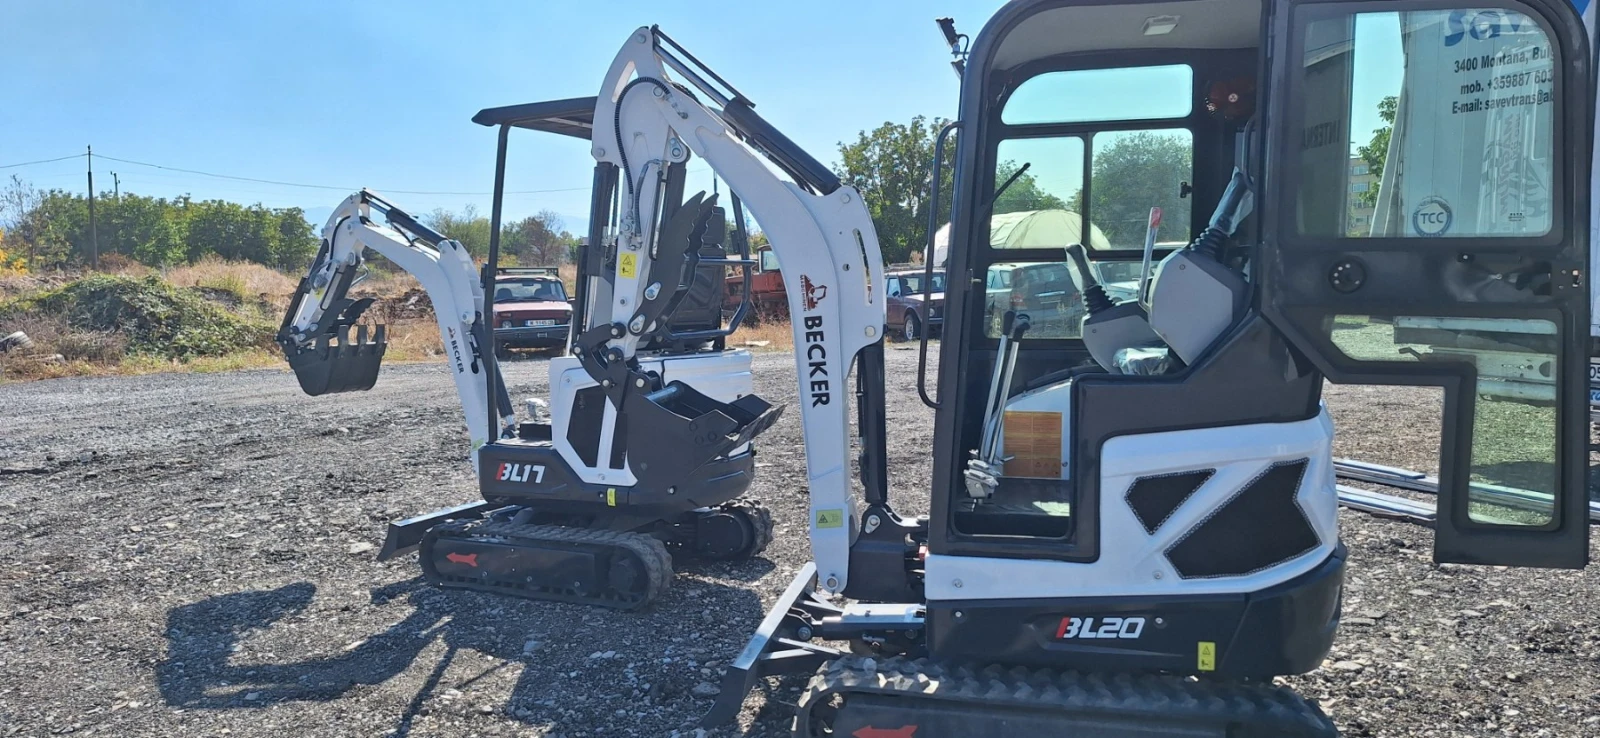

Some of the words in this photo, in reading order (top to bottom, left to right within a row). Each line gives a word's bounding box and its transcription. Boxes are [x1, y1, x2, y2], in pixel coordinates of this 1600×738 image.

[1454, 57, 1478, 74] 3400
[1481, 51, 1529, 69] Montana,
[1460, 79, 1484, 95] mob.
[1487, 71, 1532, 91] +359887
[1452, 98, 1482, 115] E-mail:
[1420, 211, 1445, 225] TCC
[451, 339, 465, 374] BECKER
[804, 315, 831, 409] BECKER
[496, 463, 546, 484] BL17
[1056, 616, 1146, 639] BL20
